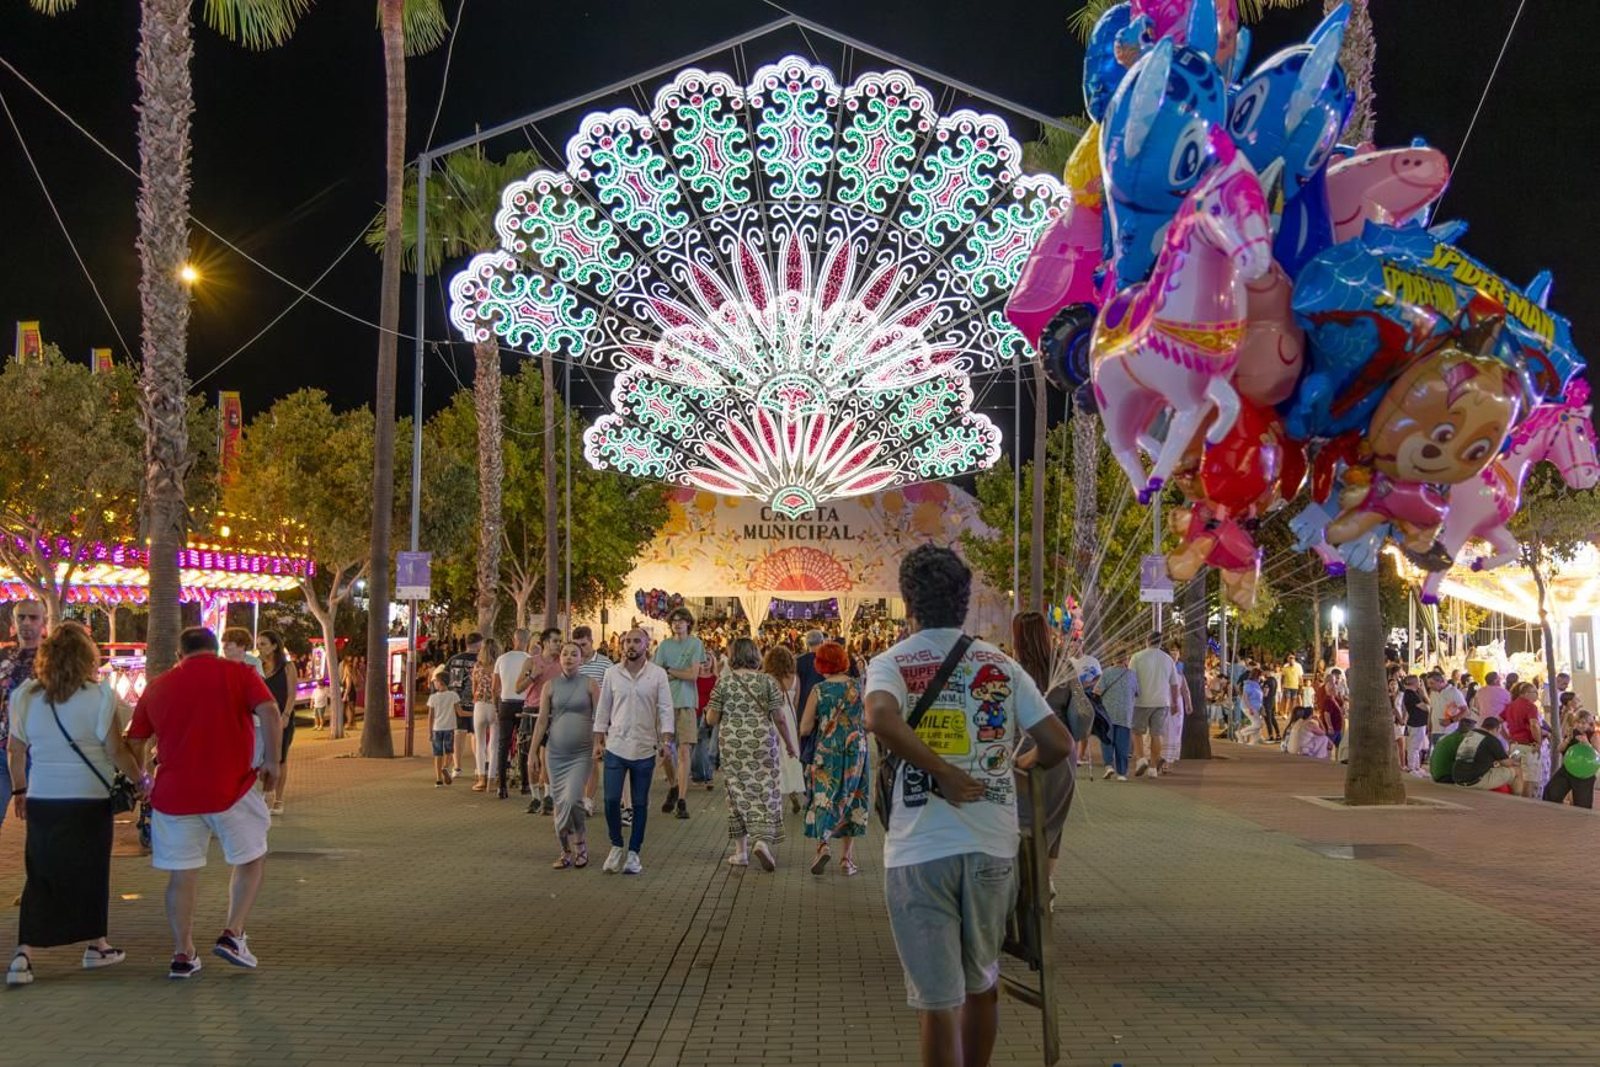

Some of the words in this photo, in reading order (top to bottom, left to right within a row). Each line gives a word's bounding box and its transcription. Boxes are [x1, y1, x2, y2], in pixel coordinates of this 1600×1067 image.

[1423, 243, 1556, 350] SPIDER-MAN
[760, 506, 840, 522] CAETA
[743, 524, 855, 540] MUNICIPAL
[894, 650, 940, 663] PIXEL
[918, 715, 951, 729] MILE
